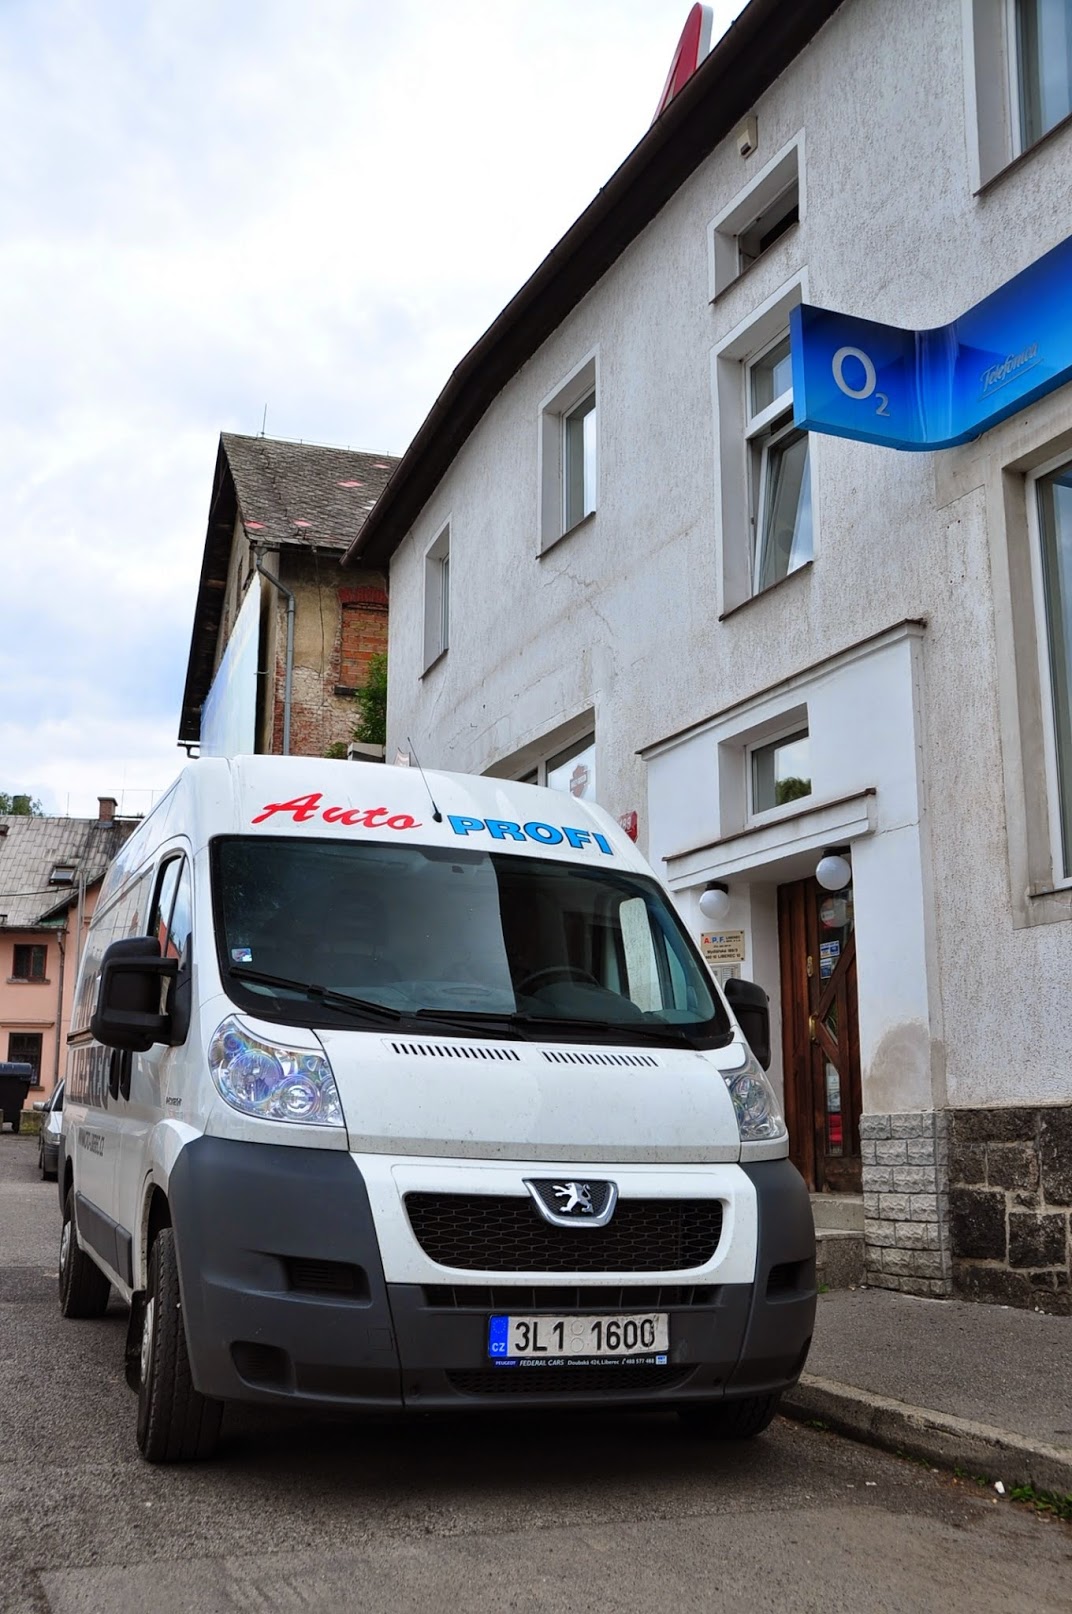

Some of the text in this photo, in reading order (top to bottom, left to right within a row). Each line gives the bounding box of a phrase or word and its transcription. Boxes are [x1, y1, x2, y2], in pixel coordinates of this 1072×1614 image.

[251, 792, 614, 855] Auto PROFI
[492, 1318, 656, 1352] CZ 3L1 1600
[519, 1359, 547, 1367] FEDERAL
